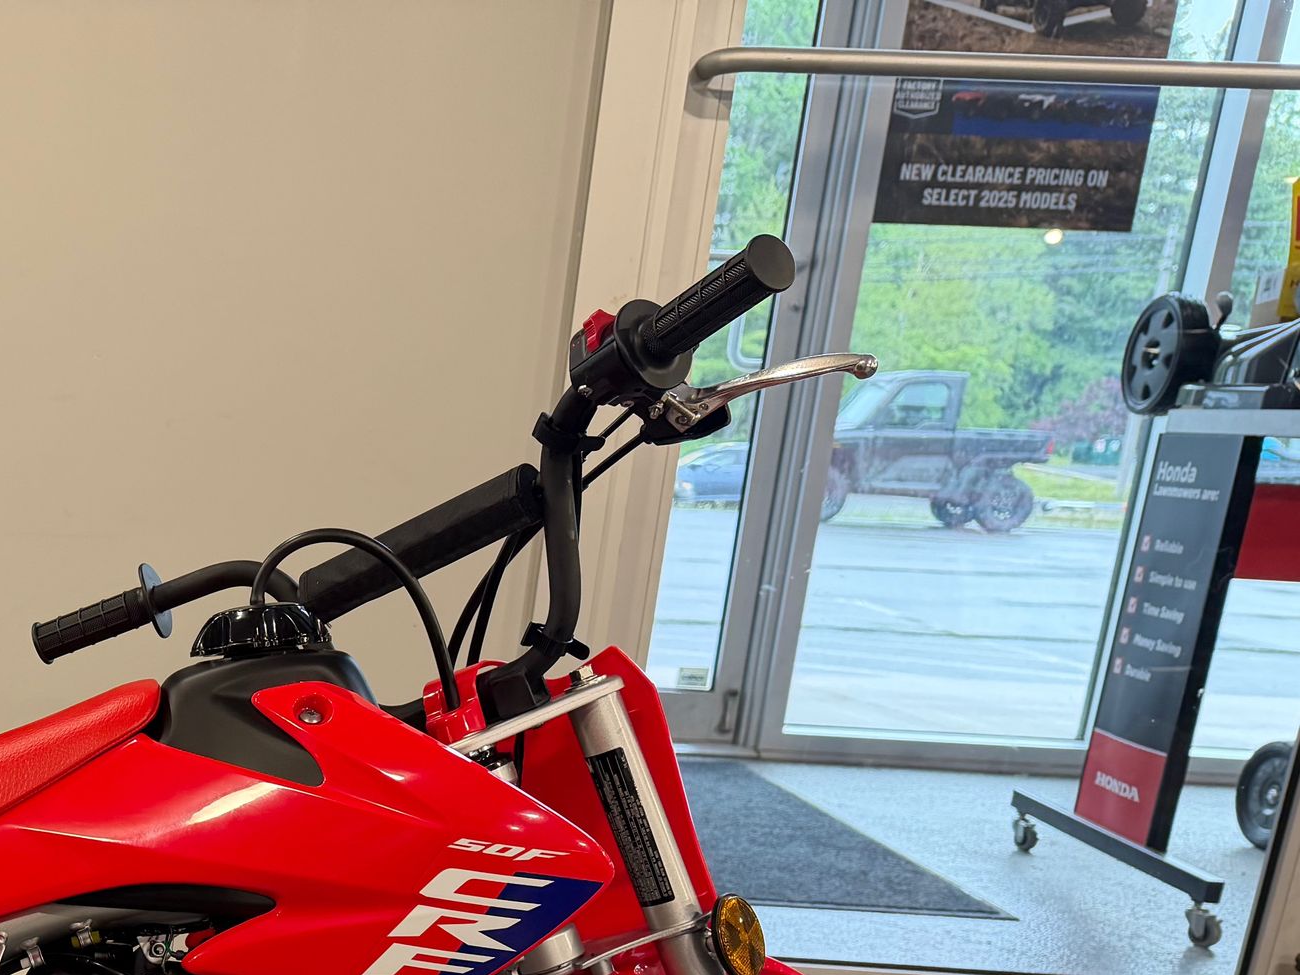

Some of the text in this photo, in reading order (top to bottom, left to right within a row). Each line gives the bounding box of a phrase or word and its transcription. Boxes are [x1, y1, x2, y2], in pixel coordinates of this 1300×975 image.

[900, 163, 1109, 187] NEW CLEARANCE PRICING ON
[922, 188, 1078, 210] SELECT 2025 MODELS
[1156, 461, 1198, 484] Honda
[1095, 770, 1140, 803] HONDA
[447, 838, 571, 861] 50F
